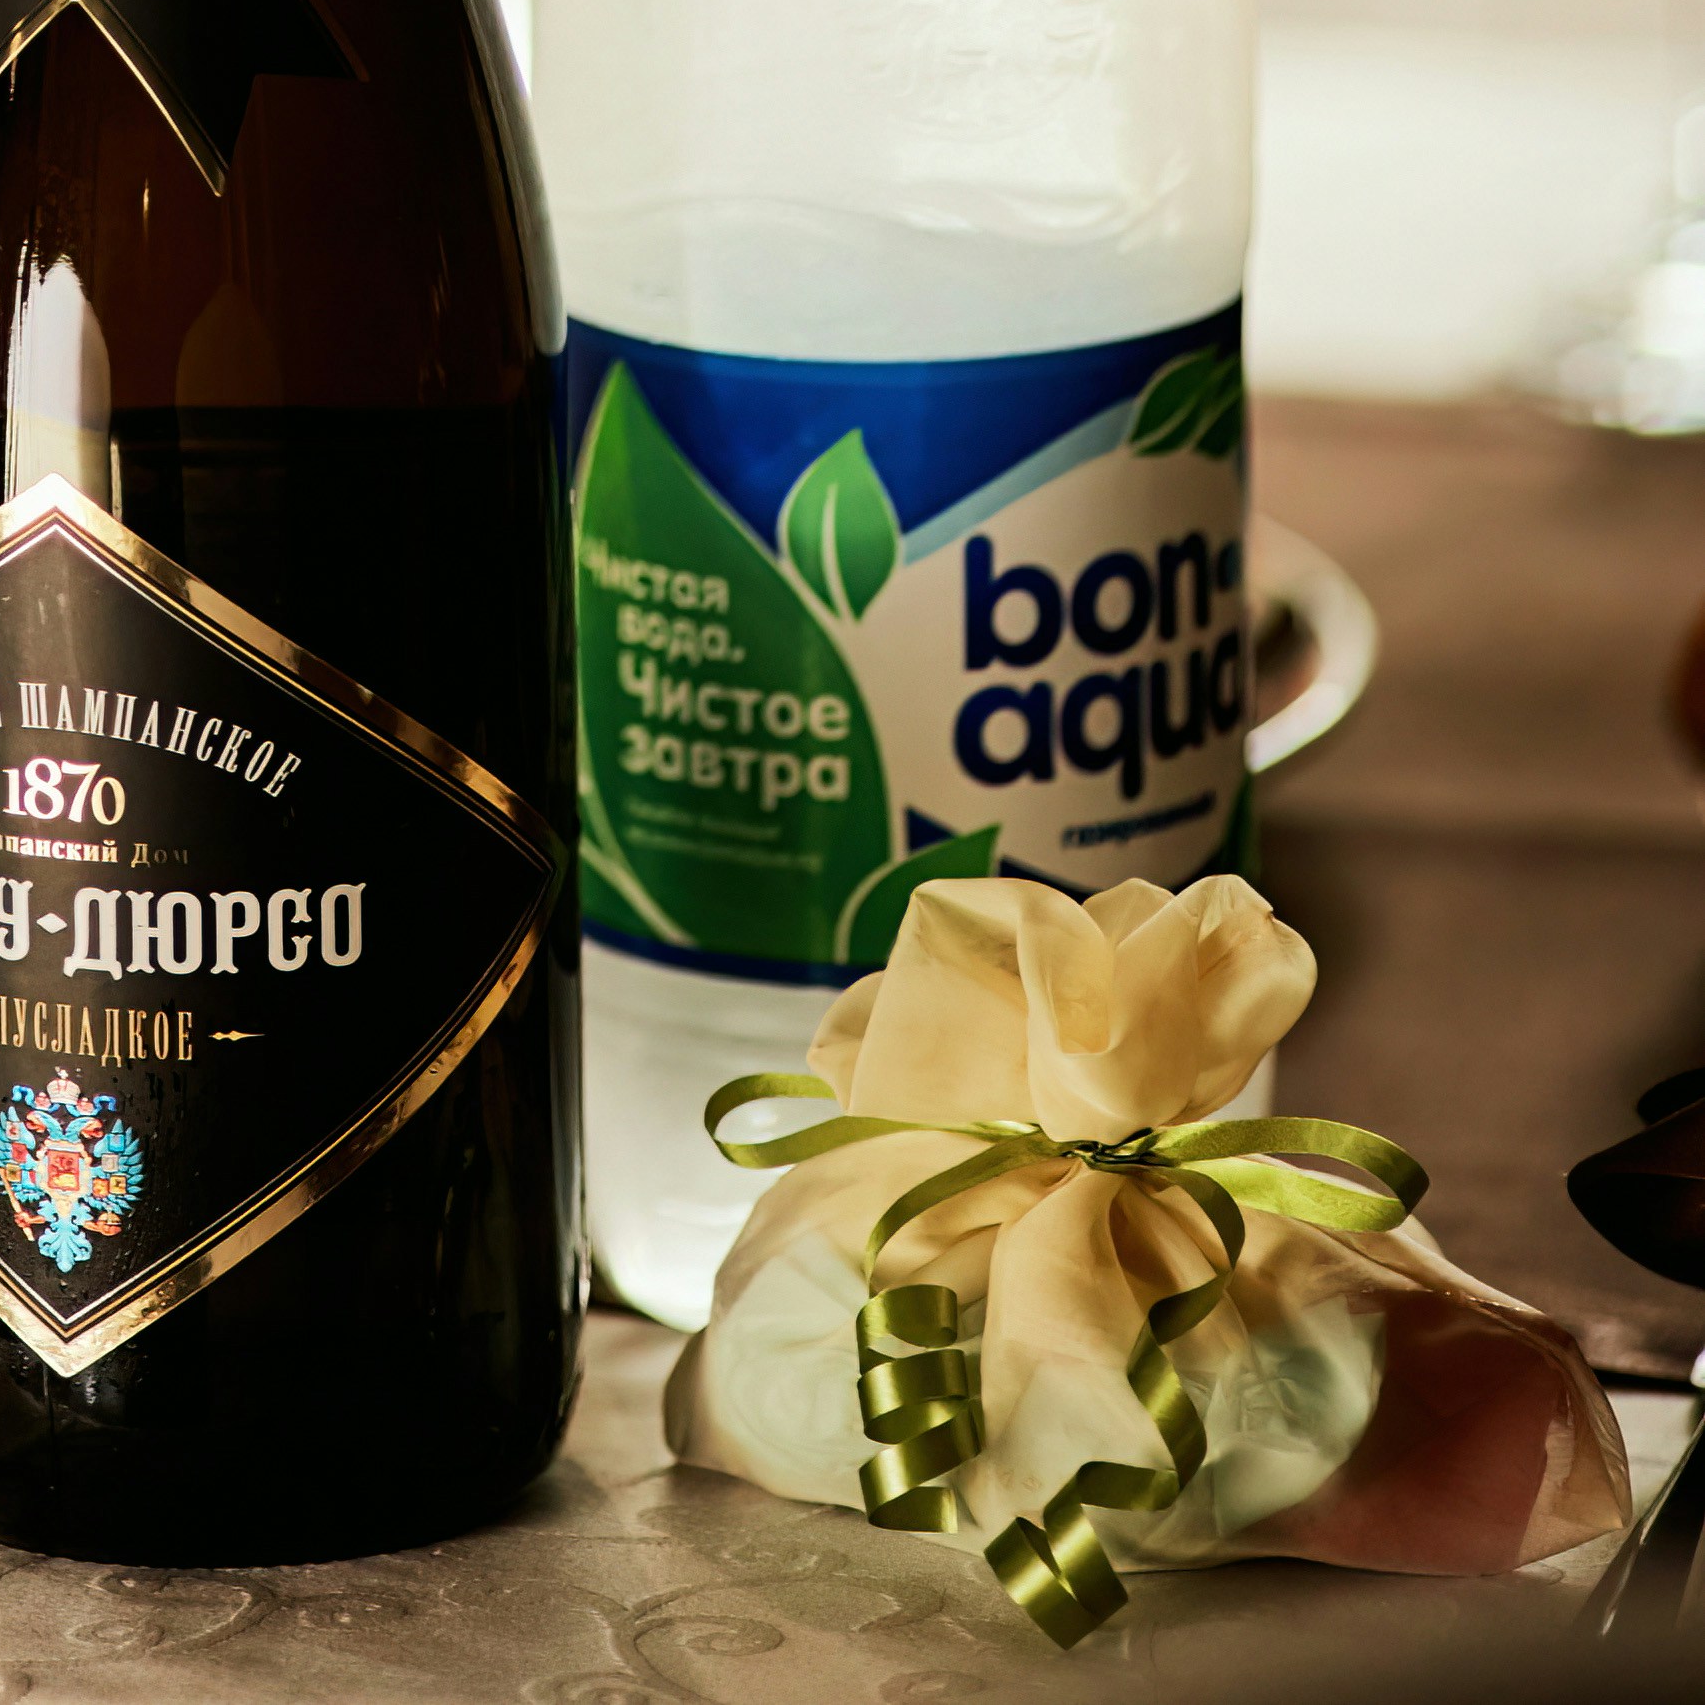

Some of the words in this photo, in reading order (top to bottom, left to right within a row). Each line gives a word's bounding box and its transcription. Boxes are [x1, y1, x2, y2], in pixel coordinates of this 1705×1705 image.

[18, 681, 302, 798] ШАМПАНСКОЕ
[618, 651, 852, 741] Чистое
[1, 757, 127, 826] 1870
[618, 723, 852, 812] завтра
